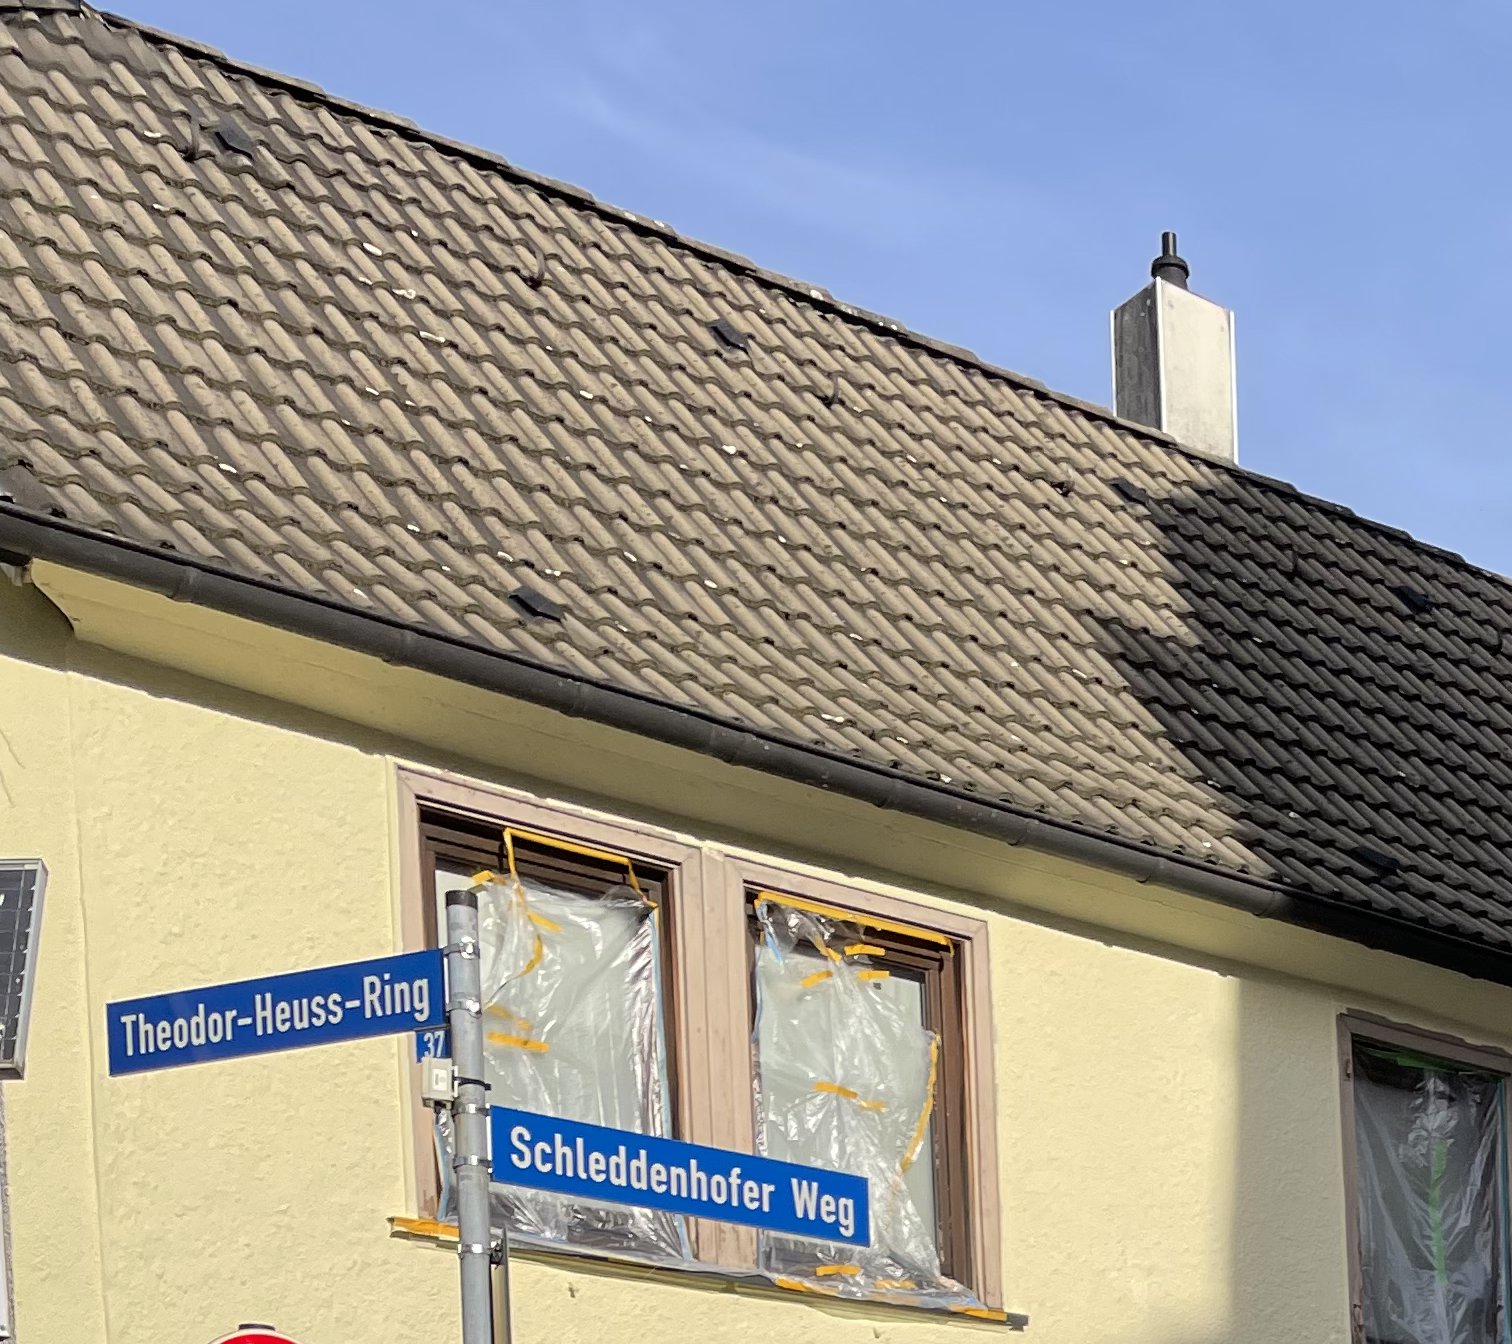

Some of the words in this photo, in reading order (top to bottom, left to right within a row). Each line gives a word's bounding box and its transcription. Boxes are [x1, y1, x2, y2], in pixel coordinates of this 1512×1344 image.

[120, 972, 430, 1057] Theodor-Heuss-Ring
[423, 1030, 445, 1058] 37
[509, 1124, 776, 1213] Schleddenhofer
[790, 1177, 855, 1238] Weg
